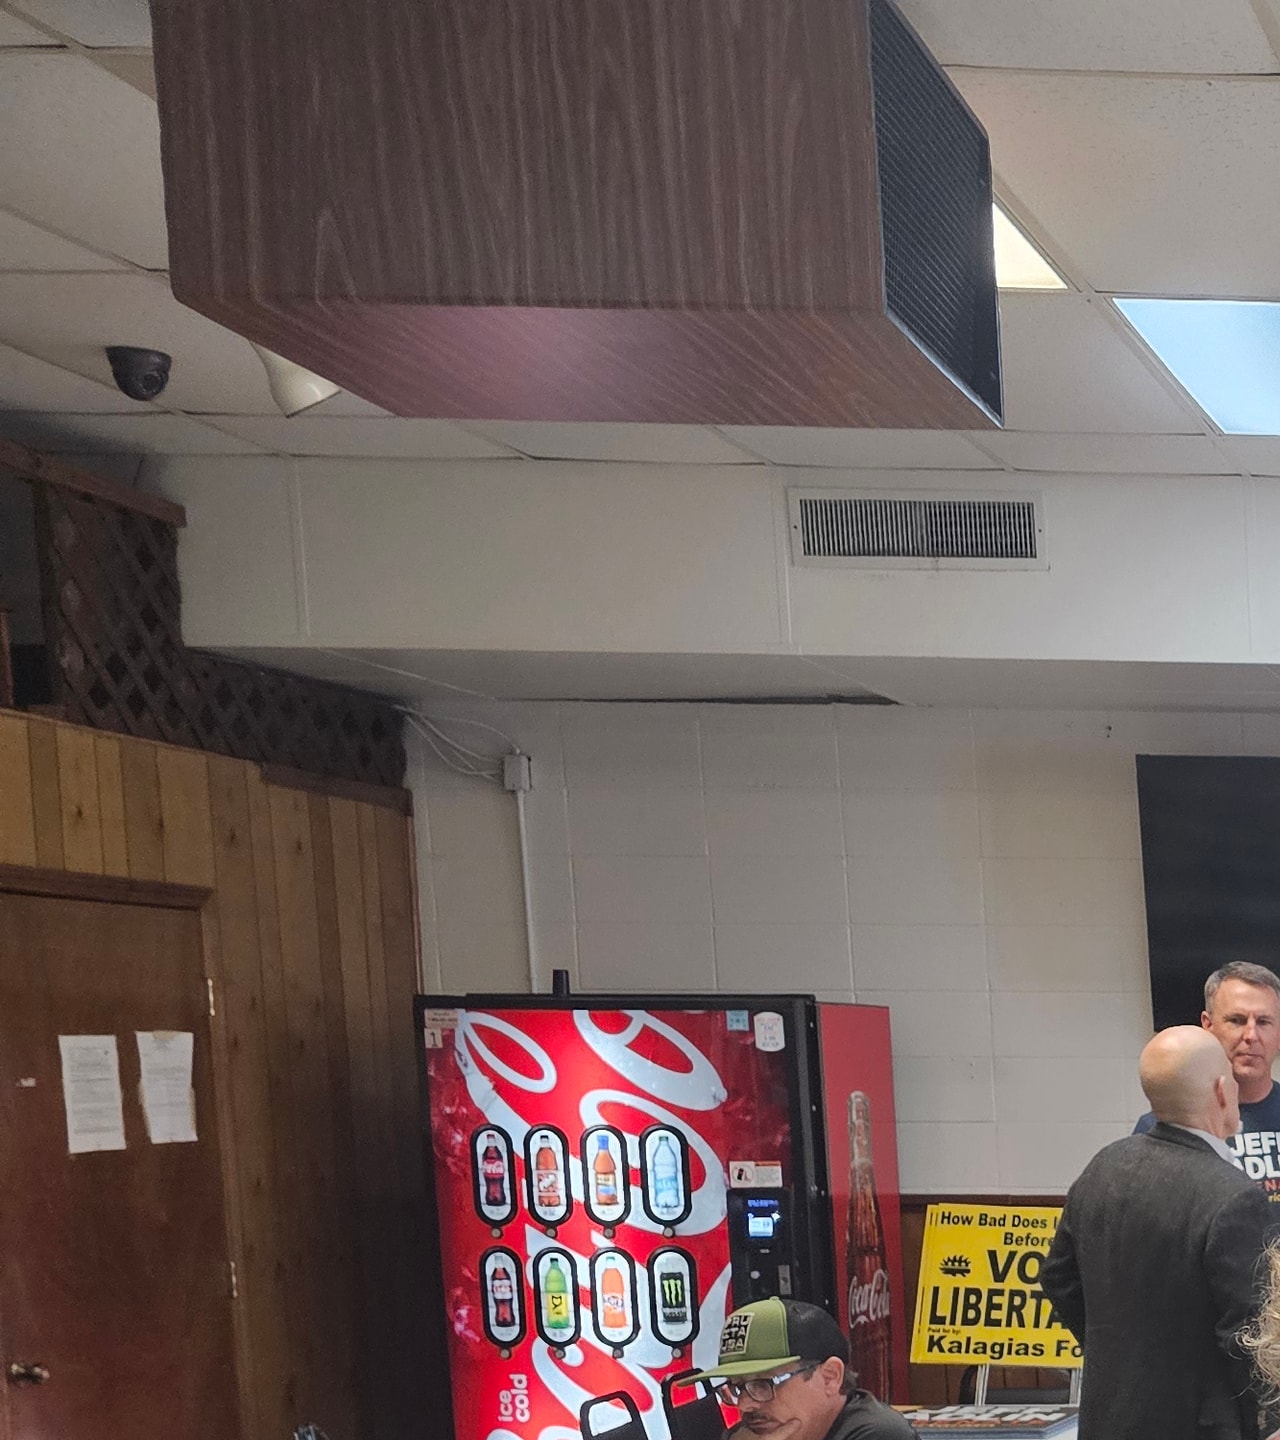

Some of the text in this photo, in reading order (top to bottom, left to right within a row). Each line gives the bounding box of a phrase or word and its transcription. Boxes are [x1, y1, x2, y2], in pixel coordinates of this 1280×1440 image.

[940, 1211, 974, 1227] How
[978, 1213, 1007, 1228] Bad
[1011, 1215, 1047, 1229] Does
[987, 1249, 1047, 1285] VO
[927, 1335, 1083, 1360] Kalagias Fo
[497, 1389, 514, 1422] ice
[508, 1373, 530, 1423] cold
